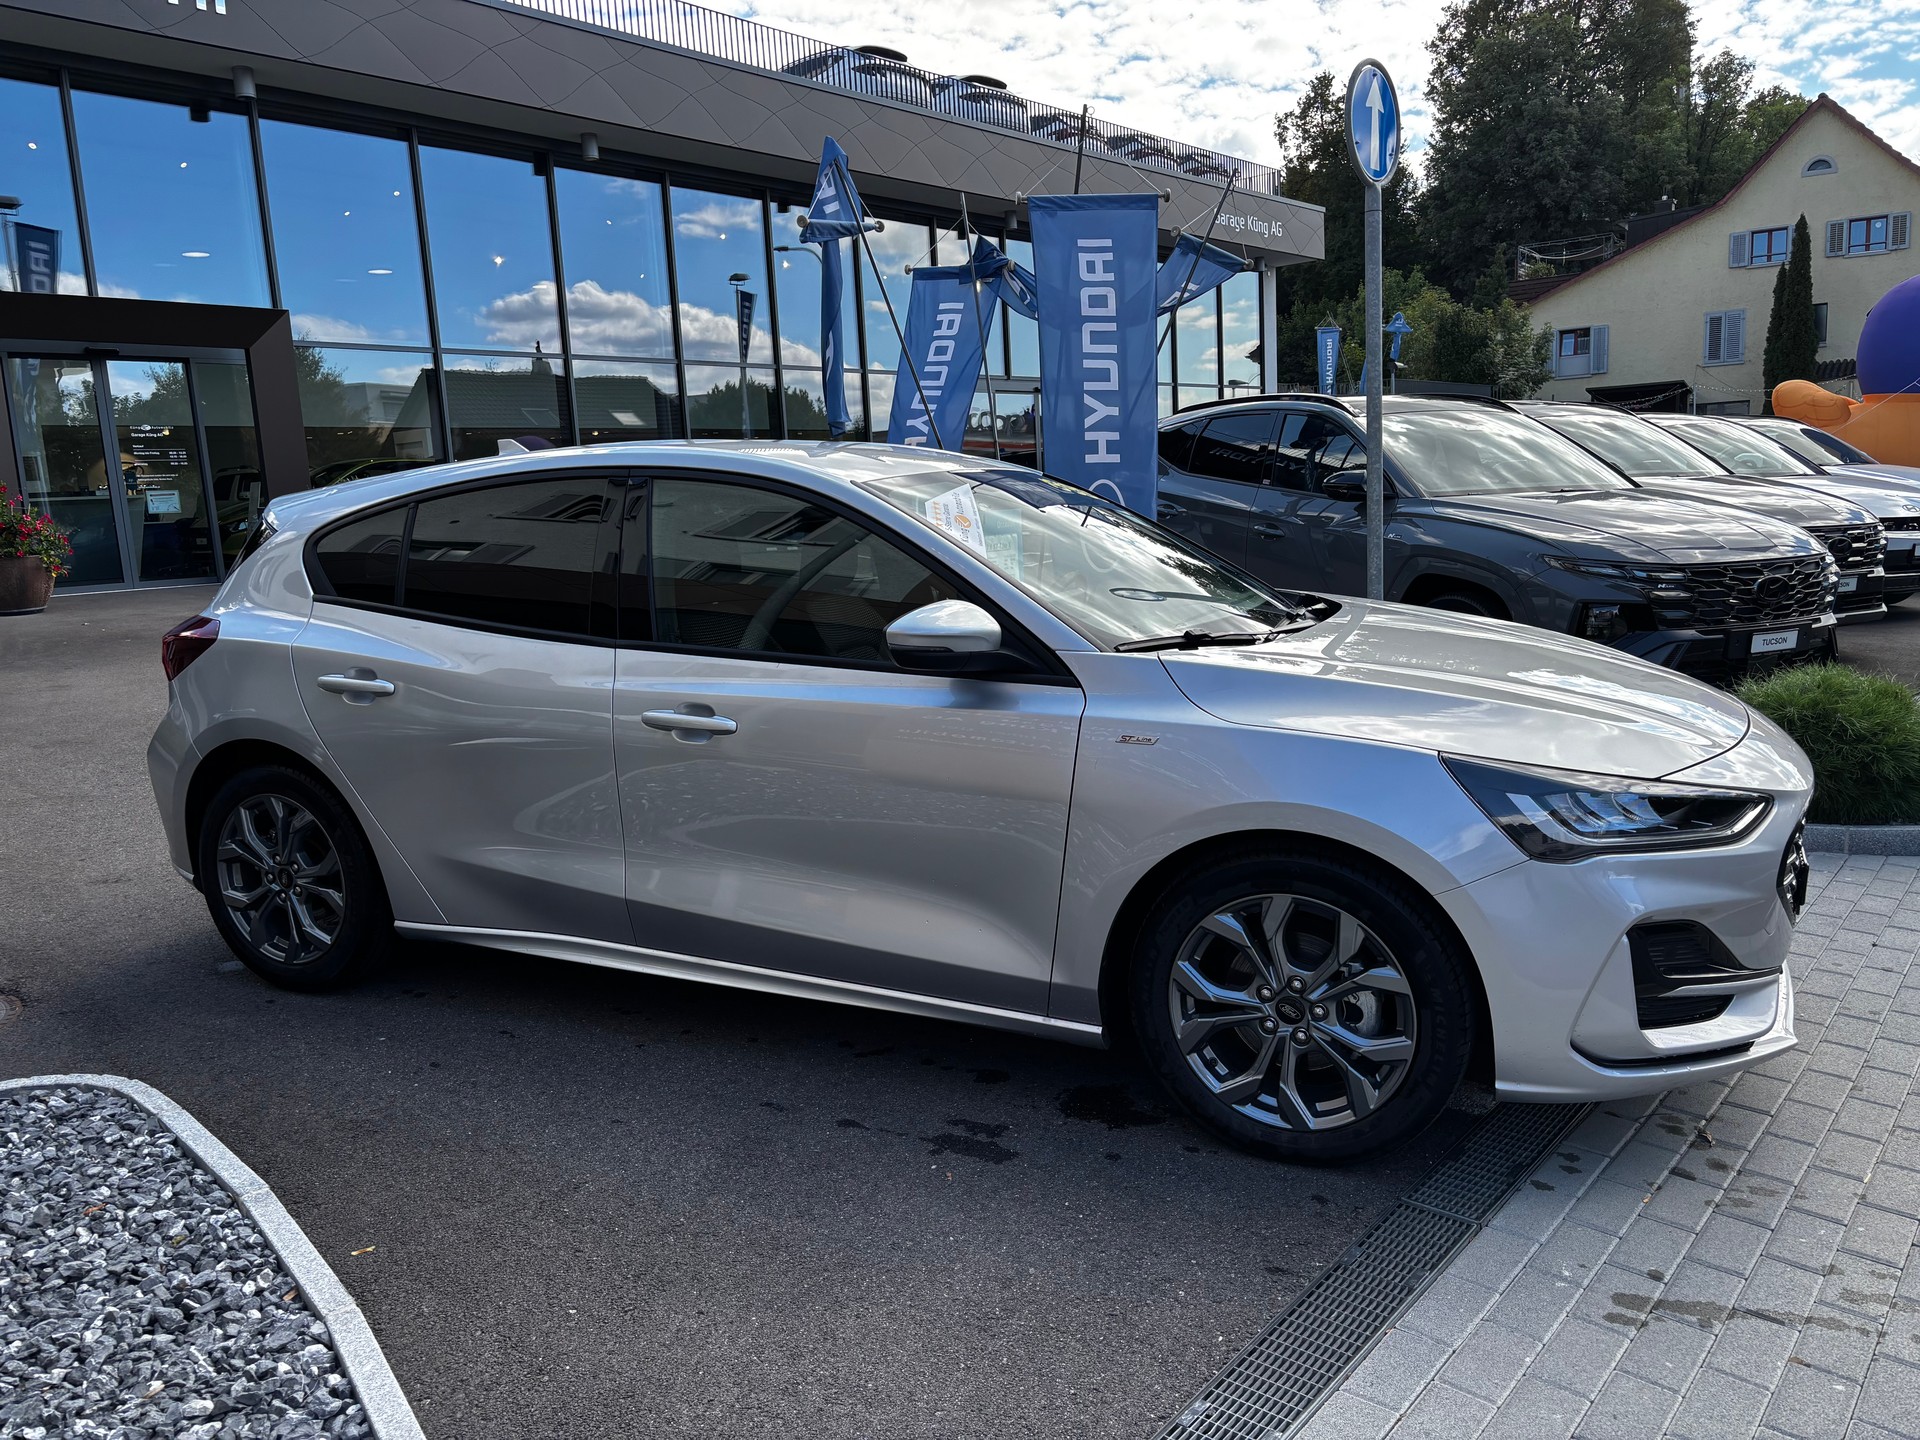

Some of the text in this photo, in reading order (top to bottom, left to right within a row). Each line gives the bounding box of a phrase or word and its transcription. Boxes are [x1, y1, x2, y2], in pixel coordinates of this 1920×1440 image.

[1247, 214, 1269, 238] Küng
[1270, 220, 1283, 237] AG
[1077, 238, 1121, 464] HYUNDAI
[1761, 636, 1789, 647] TUCSON
[1281, 1004, 1298, 1017] Ford
